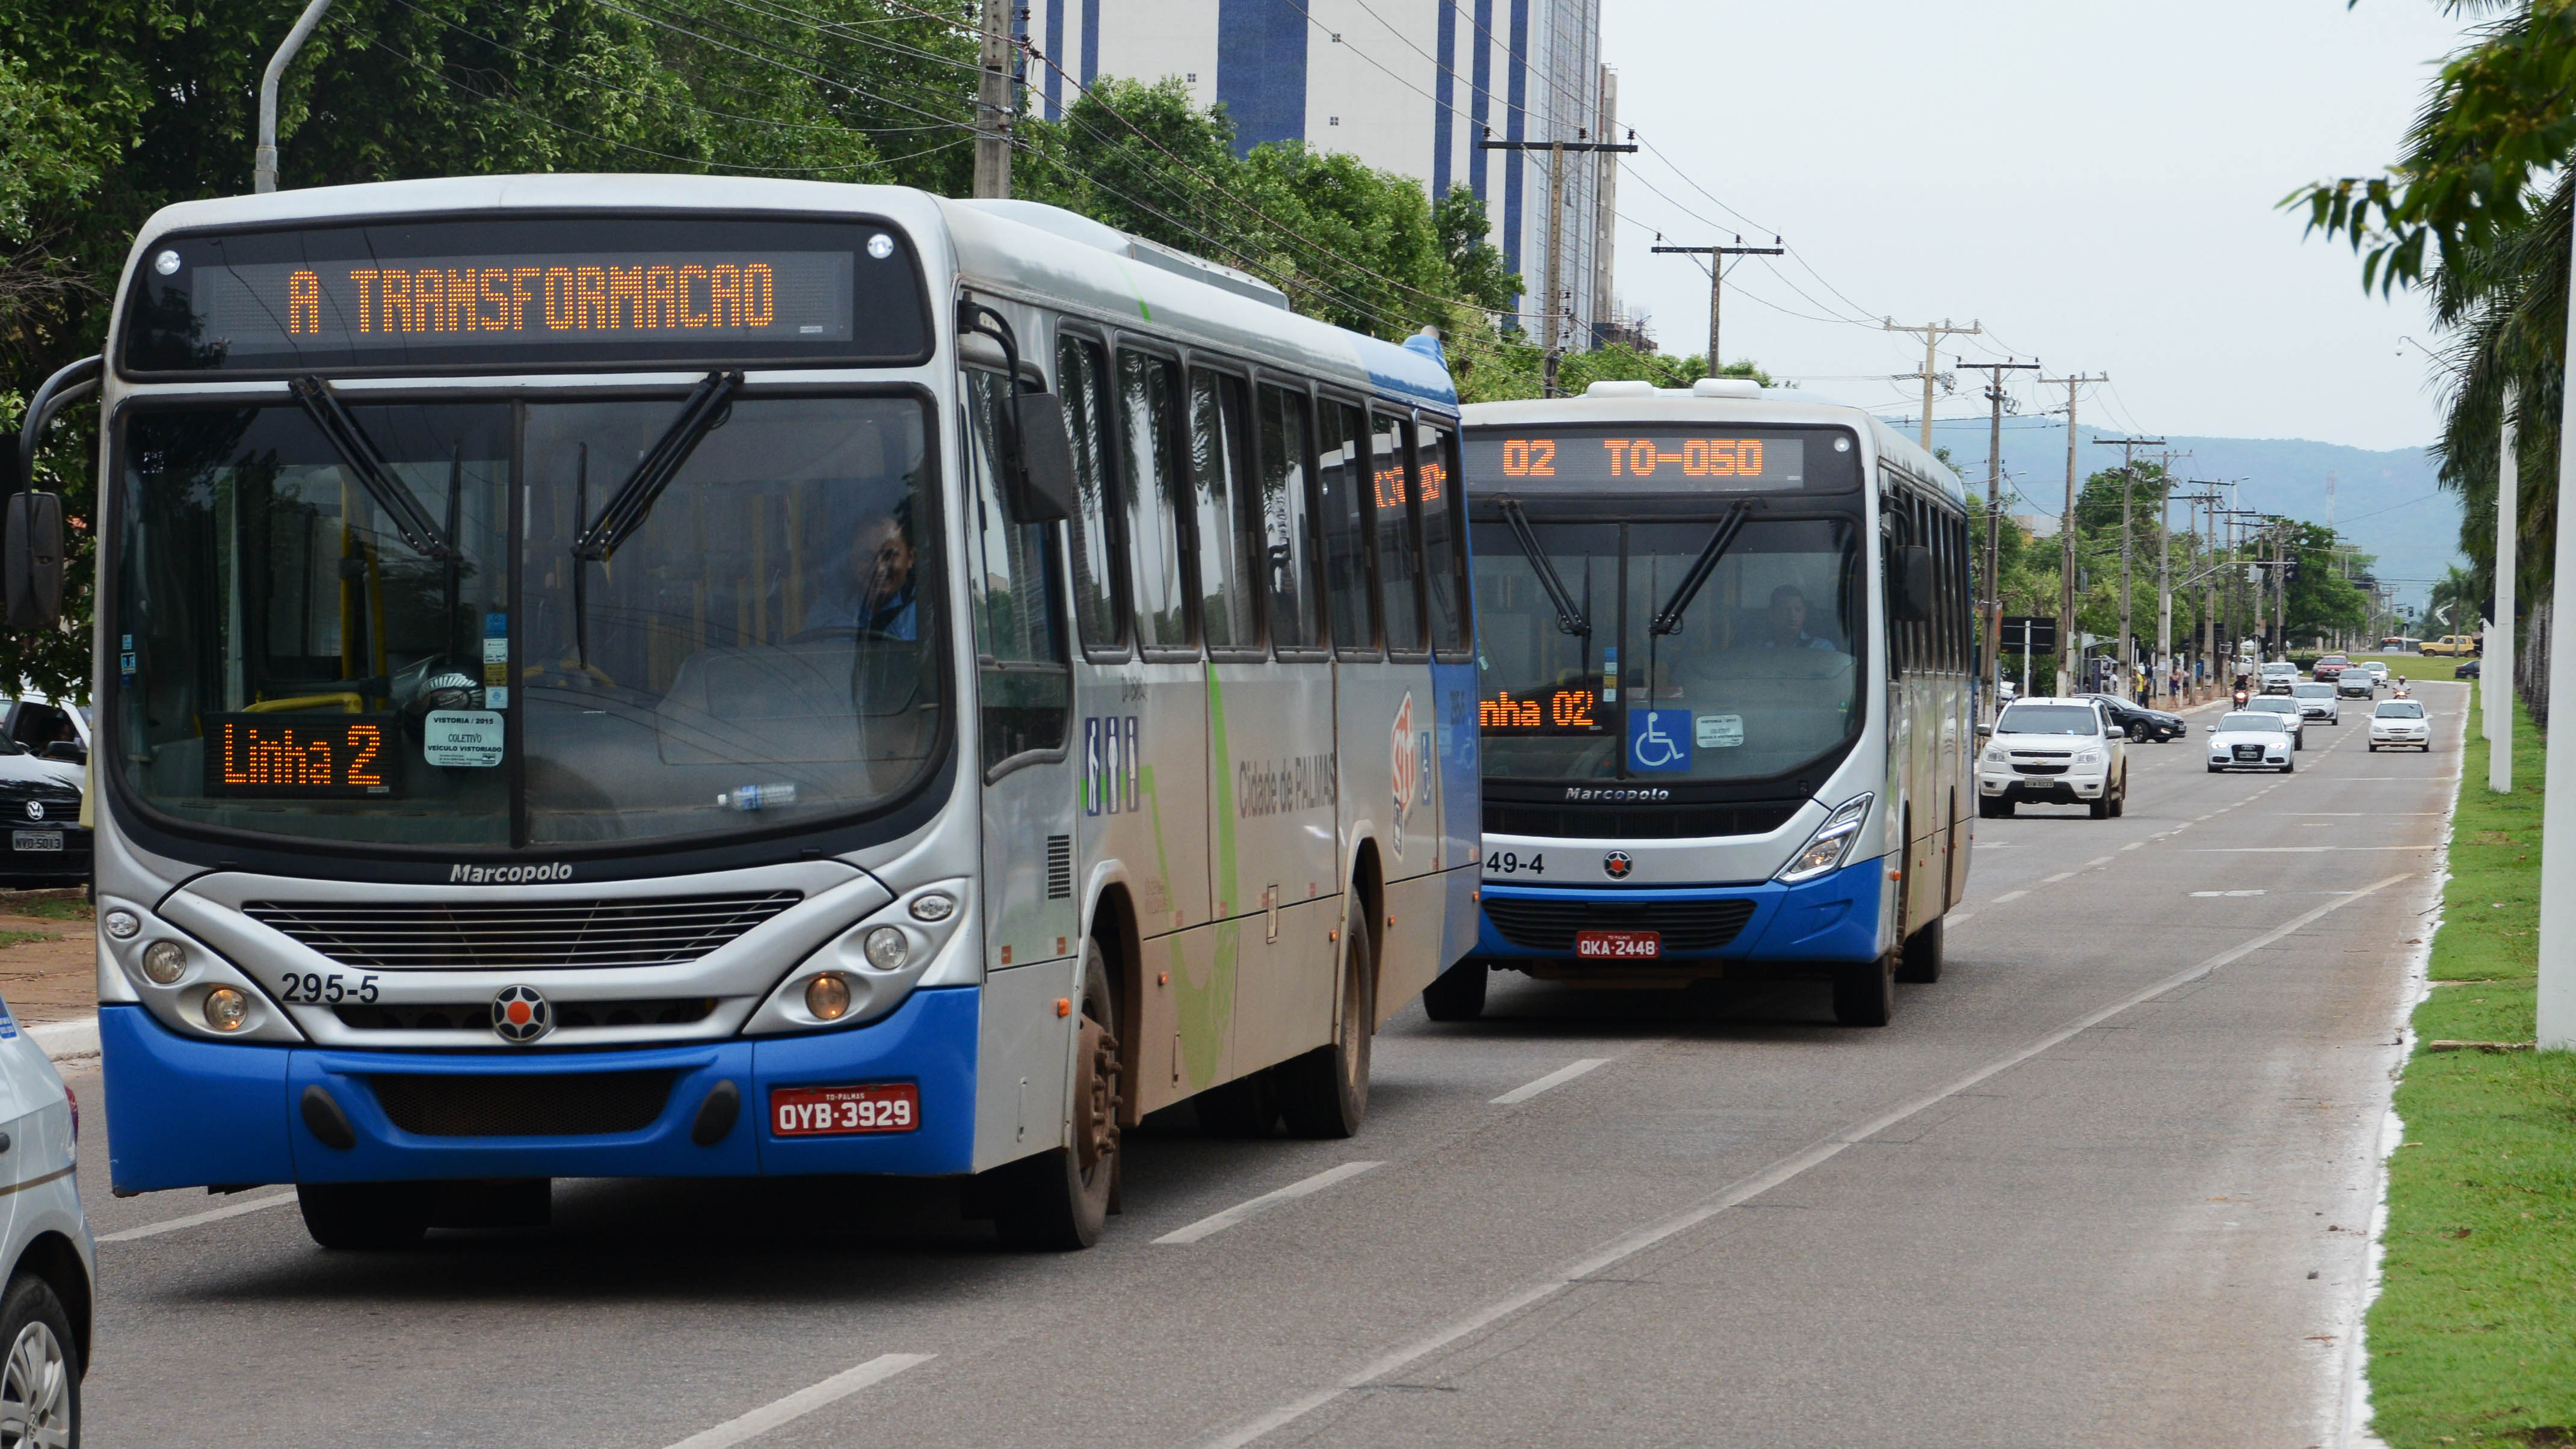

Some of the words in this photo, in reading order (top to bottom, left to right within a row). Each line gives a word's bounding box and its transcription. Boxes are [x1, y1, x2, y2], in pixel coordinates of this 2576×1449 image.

[290, 271, 318, 334] A
[351, 263, 774, 333] TRANSFORMACAO
[1503, 440, 1555, 476] 02
[1604, 440, 1762, 476] TO-050
[1552, 691, 1594, 726] 02
[225, 724, 331, 785] Linha
[348, 725, 381, 785] 2
[448, 733, 482, 743] COLETIVO
[1239, 760, 1277, 819] Cidade
[1280, 758, 1293, 813] de
[1295, 752, 1335, 811] PALMAS
[1565, 787, 1670, 802] Marcopolo
[449, 862, 573, 884] Marcopolo
[1482, 852, 1544, 875] 49-4
[281, 972, 380, 1004] 295-5
